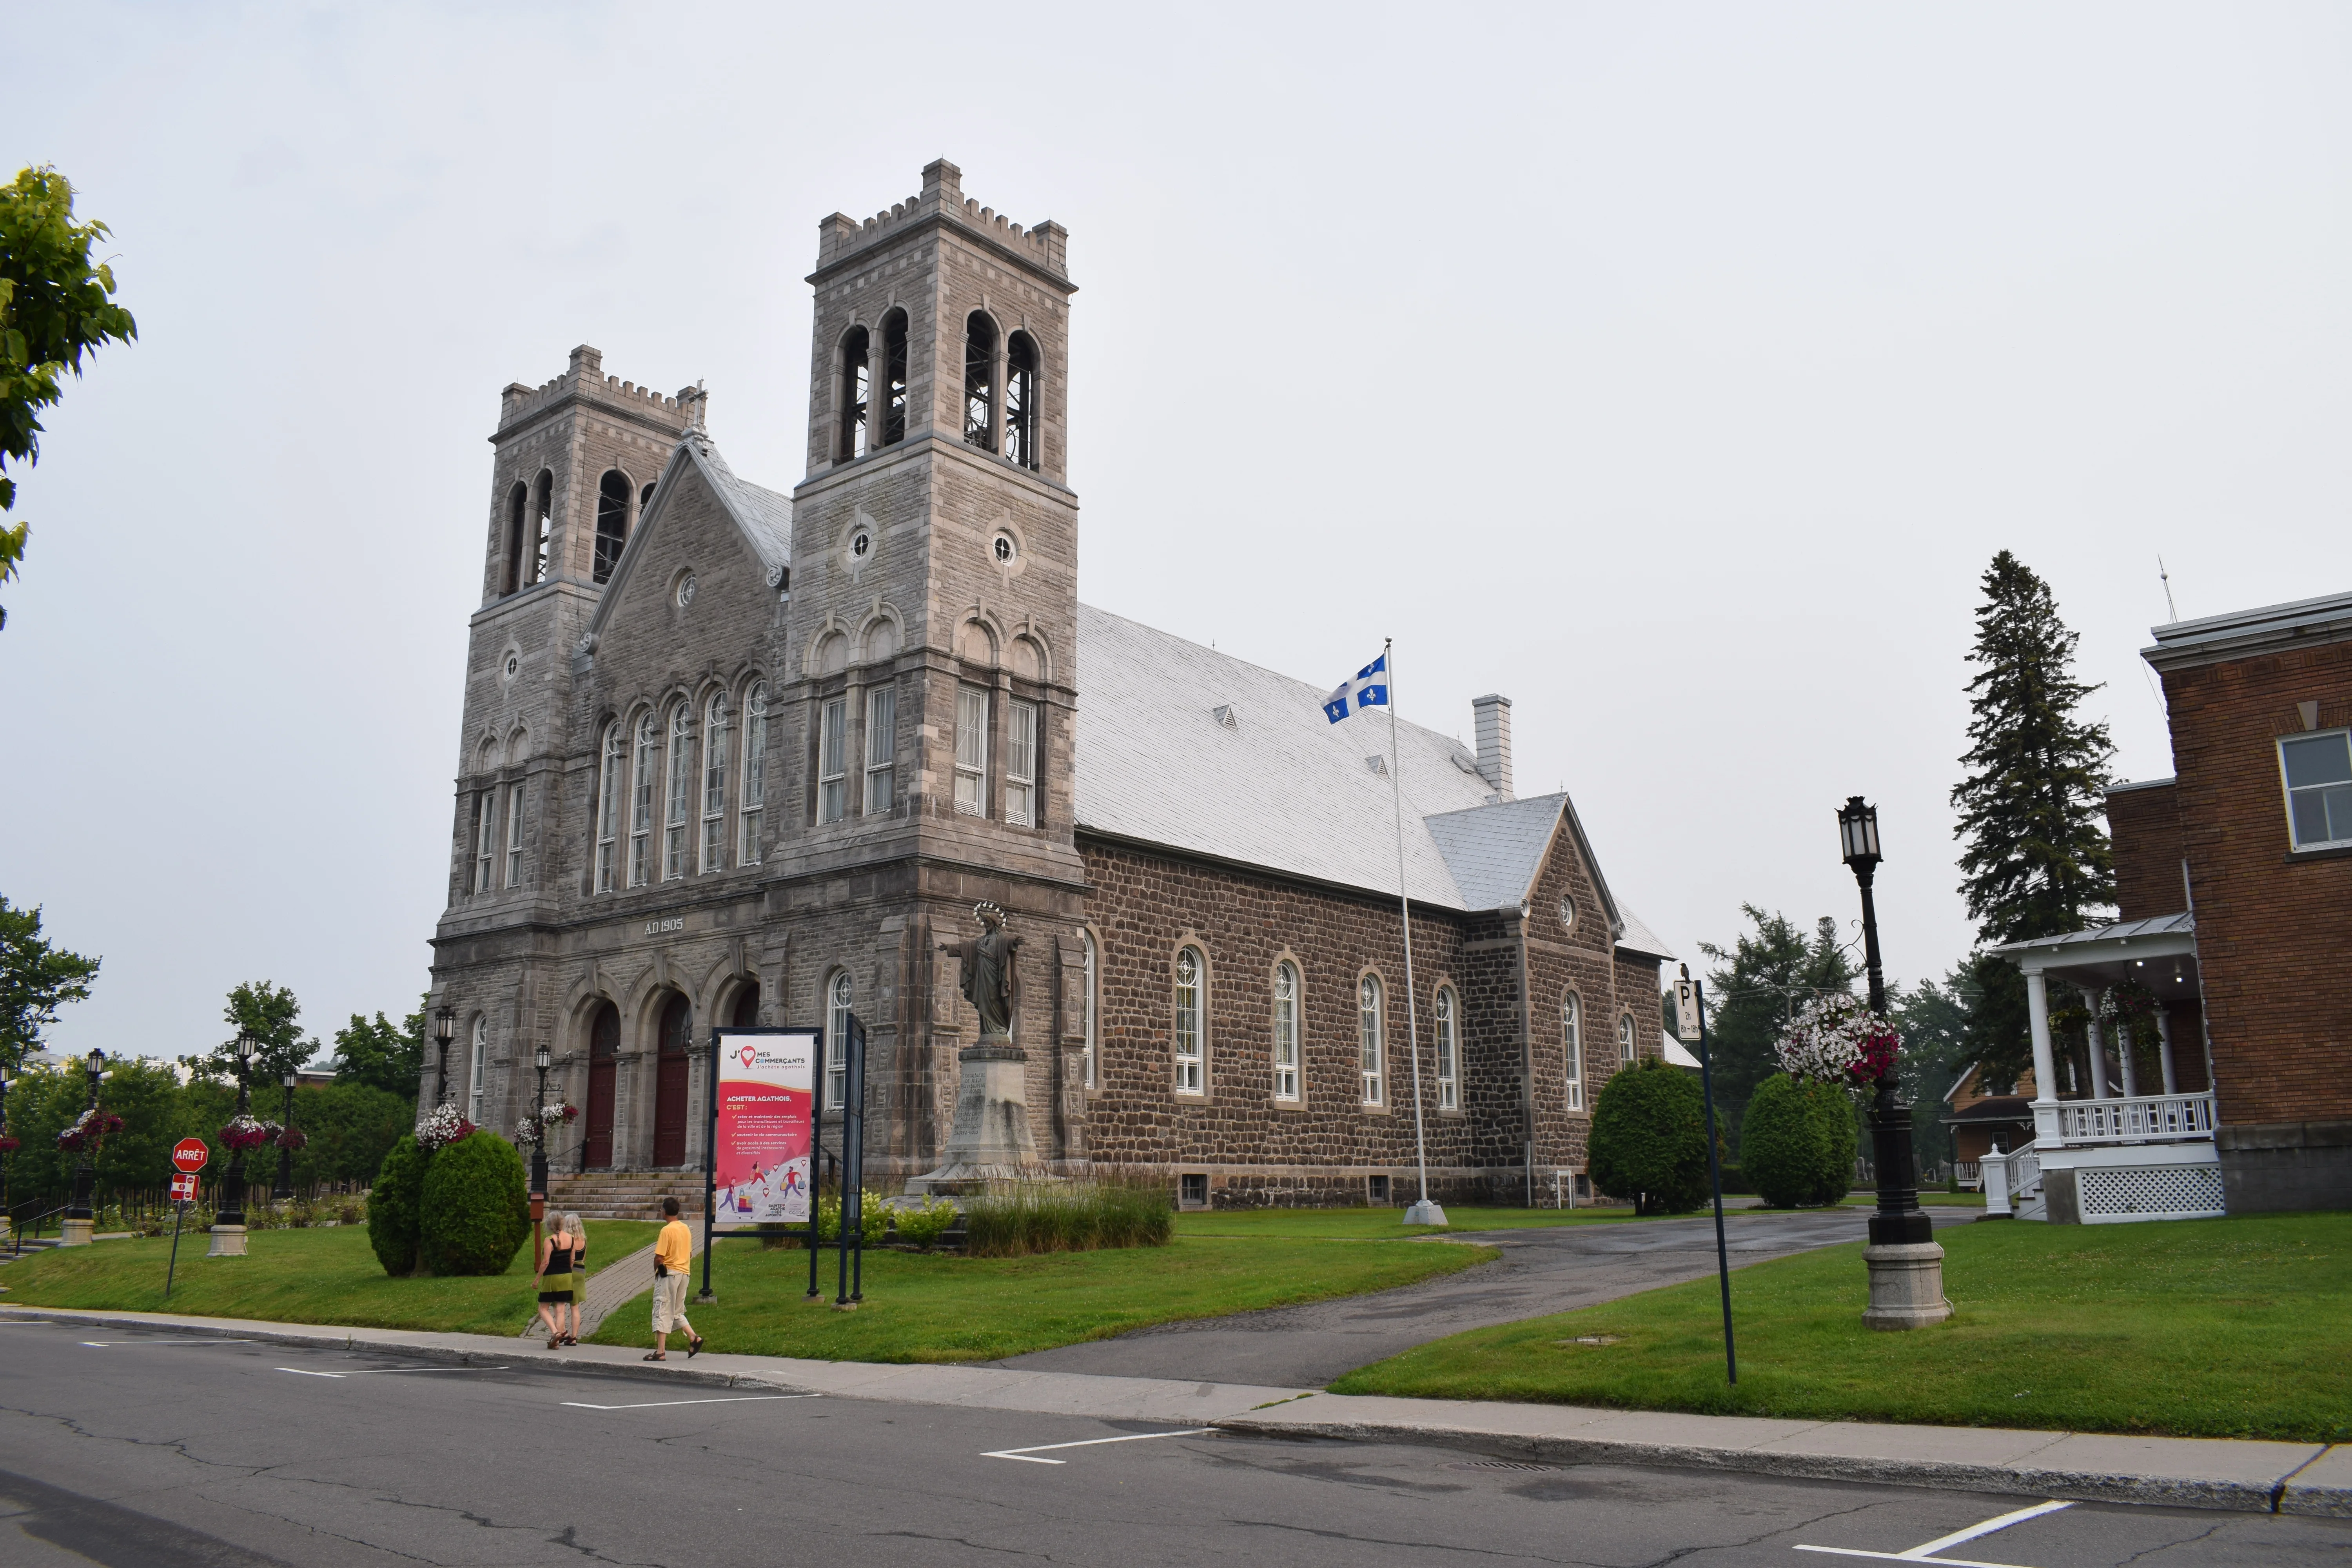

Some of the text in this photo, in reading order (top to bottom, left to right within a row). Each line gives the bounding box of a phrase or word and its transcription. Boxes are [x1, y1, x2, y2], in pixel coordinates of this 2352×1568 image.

[661, 918, 682, 932] 1905
[1681, 986, 1690, 1007] P
[176, 1149, 205, 1160] ARRÊT
